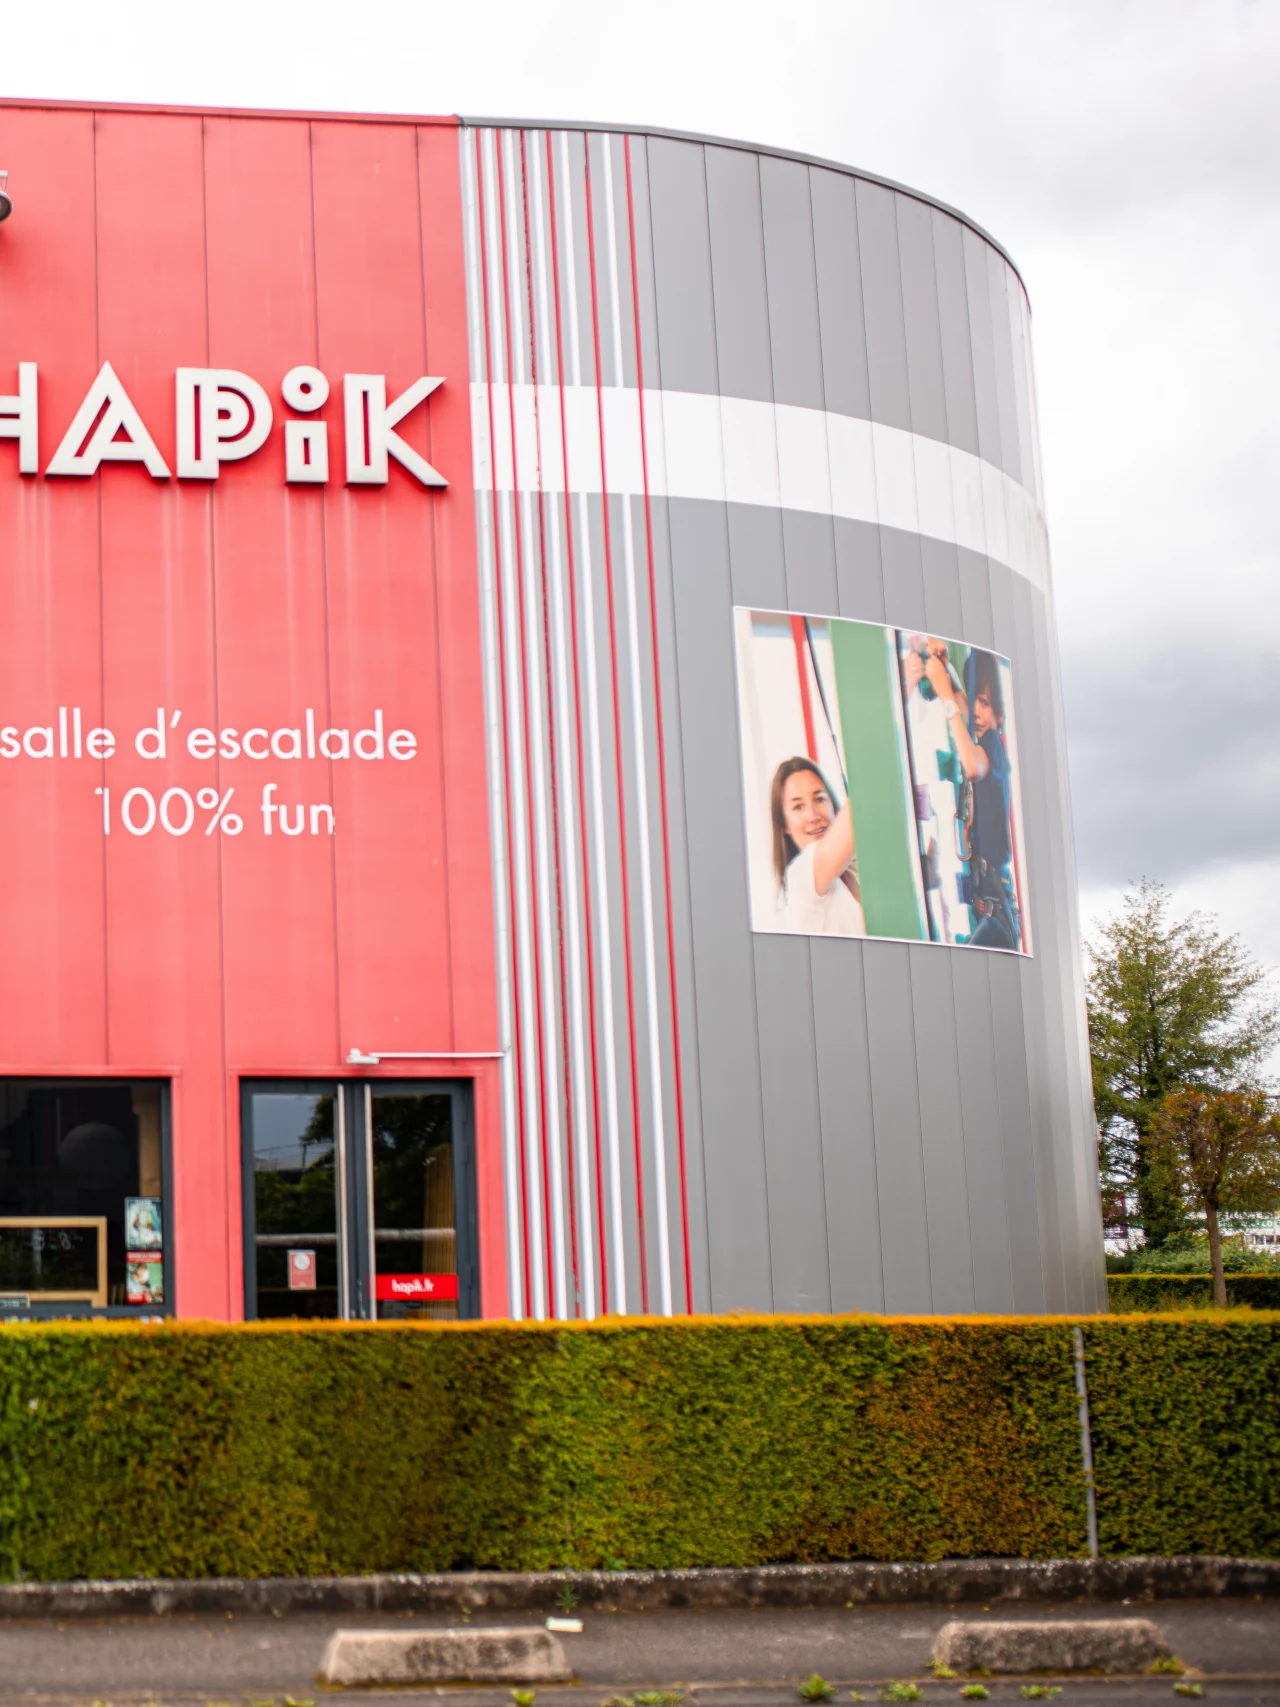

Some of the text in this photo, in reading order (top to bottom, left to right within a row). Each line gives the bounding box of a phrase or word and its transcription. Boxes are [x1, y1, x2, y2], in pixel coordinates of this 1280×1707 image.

[0, 706, 418, 761] salle d'escalade
[94, 782, 335, 836] 100% fun
